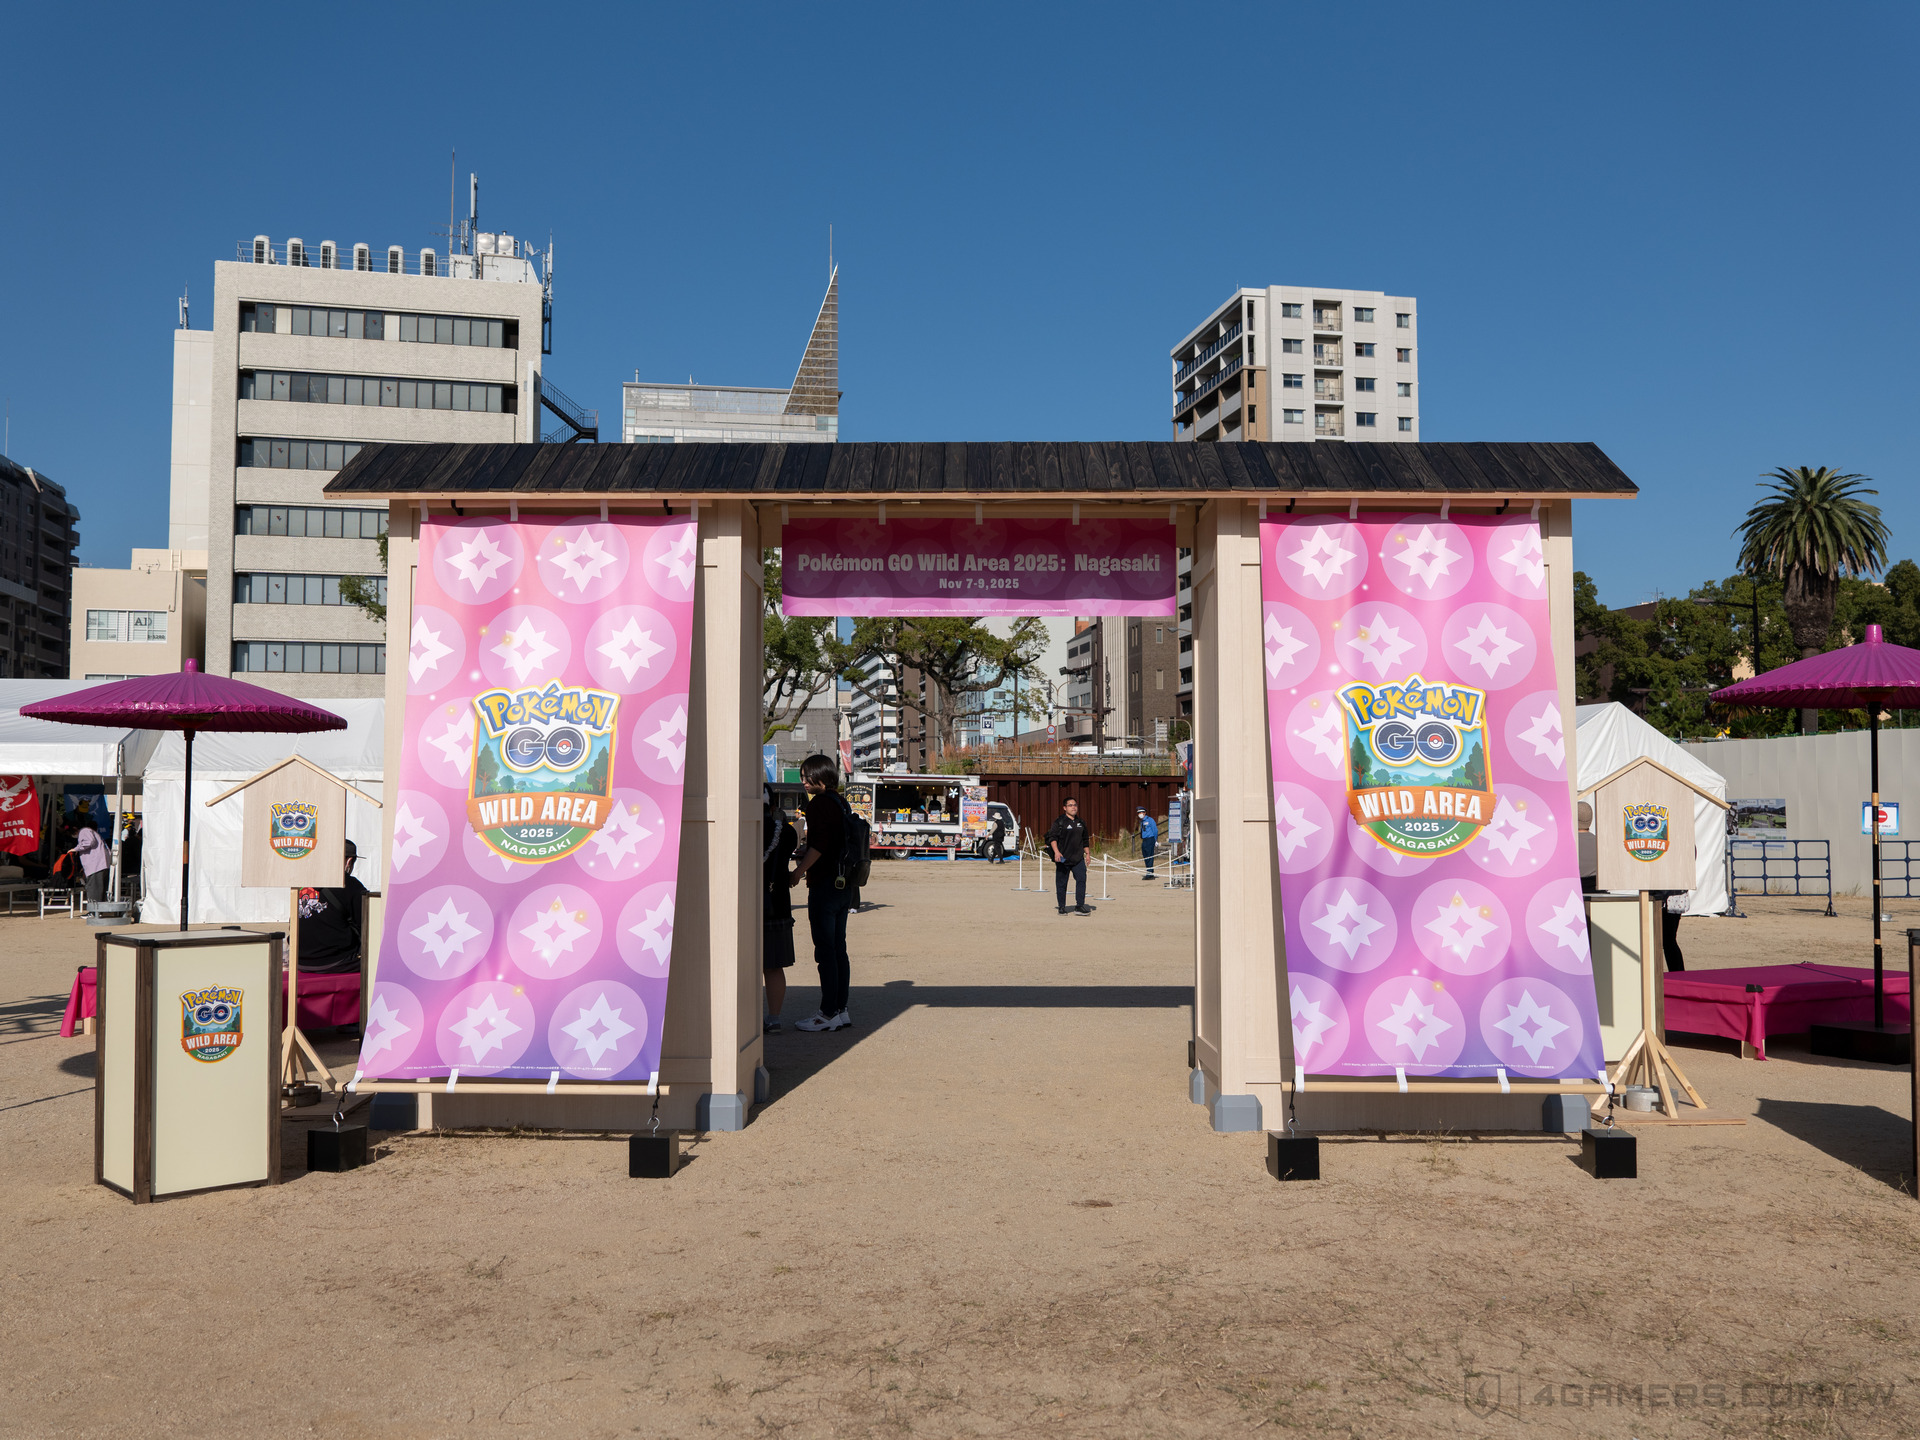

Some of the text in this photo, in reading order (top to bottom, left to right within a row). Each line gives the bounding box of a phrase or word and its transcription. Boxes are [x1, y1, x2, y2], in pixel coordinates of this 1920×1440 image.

[798, 553, 1161, 577] Pokémon GO Wild Area 2025: Nagasaki
[939, 578, 963, 589] Nov
[505, 726, 586, 768] GO
[1375, 721, 1457, 762] GO
[478, 796, 598, 826] WILD AREA
[1356, 790, 1482, 820] WILD AREA
[3, 819, 24, 828] TEAM
[282, 814, 308, 828] GO
[1404, 822, 1440, 832] 2025
[1634, 816, 1660, 830] GO
[520, 828, 554, 838] 2025
[1386, 832, 1461, 850] NAGASAKI
[273, 838, 313, 848] WILD AREA
[500, 838, 572, 856] NAGASAKI
[1627, 840, 1666, 850] WILD AREA
[196, 1004, 230, 1024] GO
[186, 1034, 237, 1050] WILD AREA
